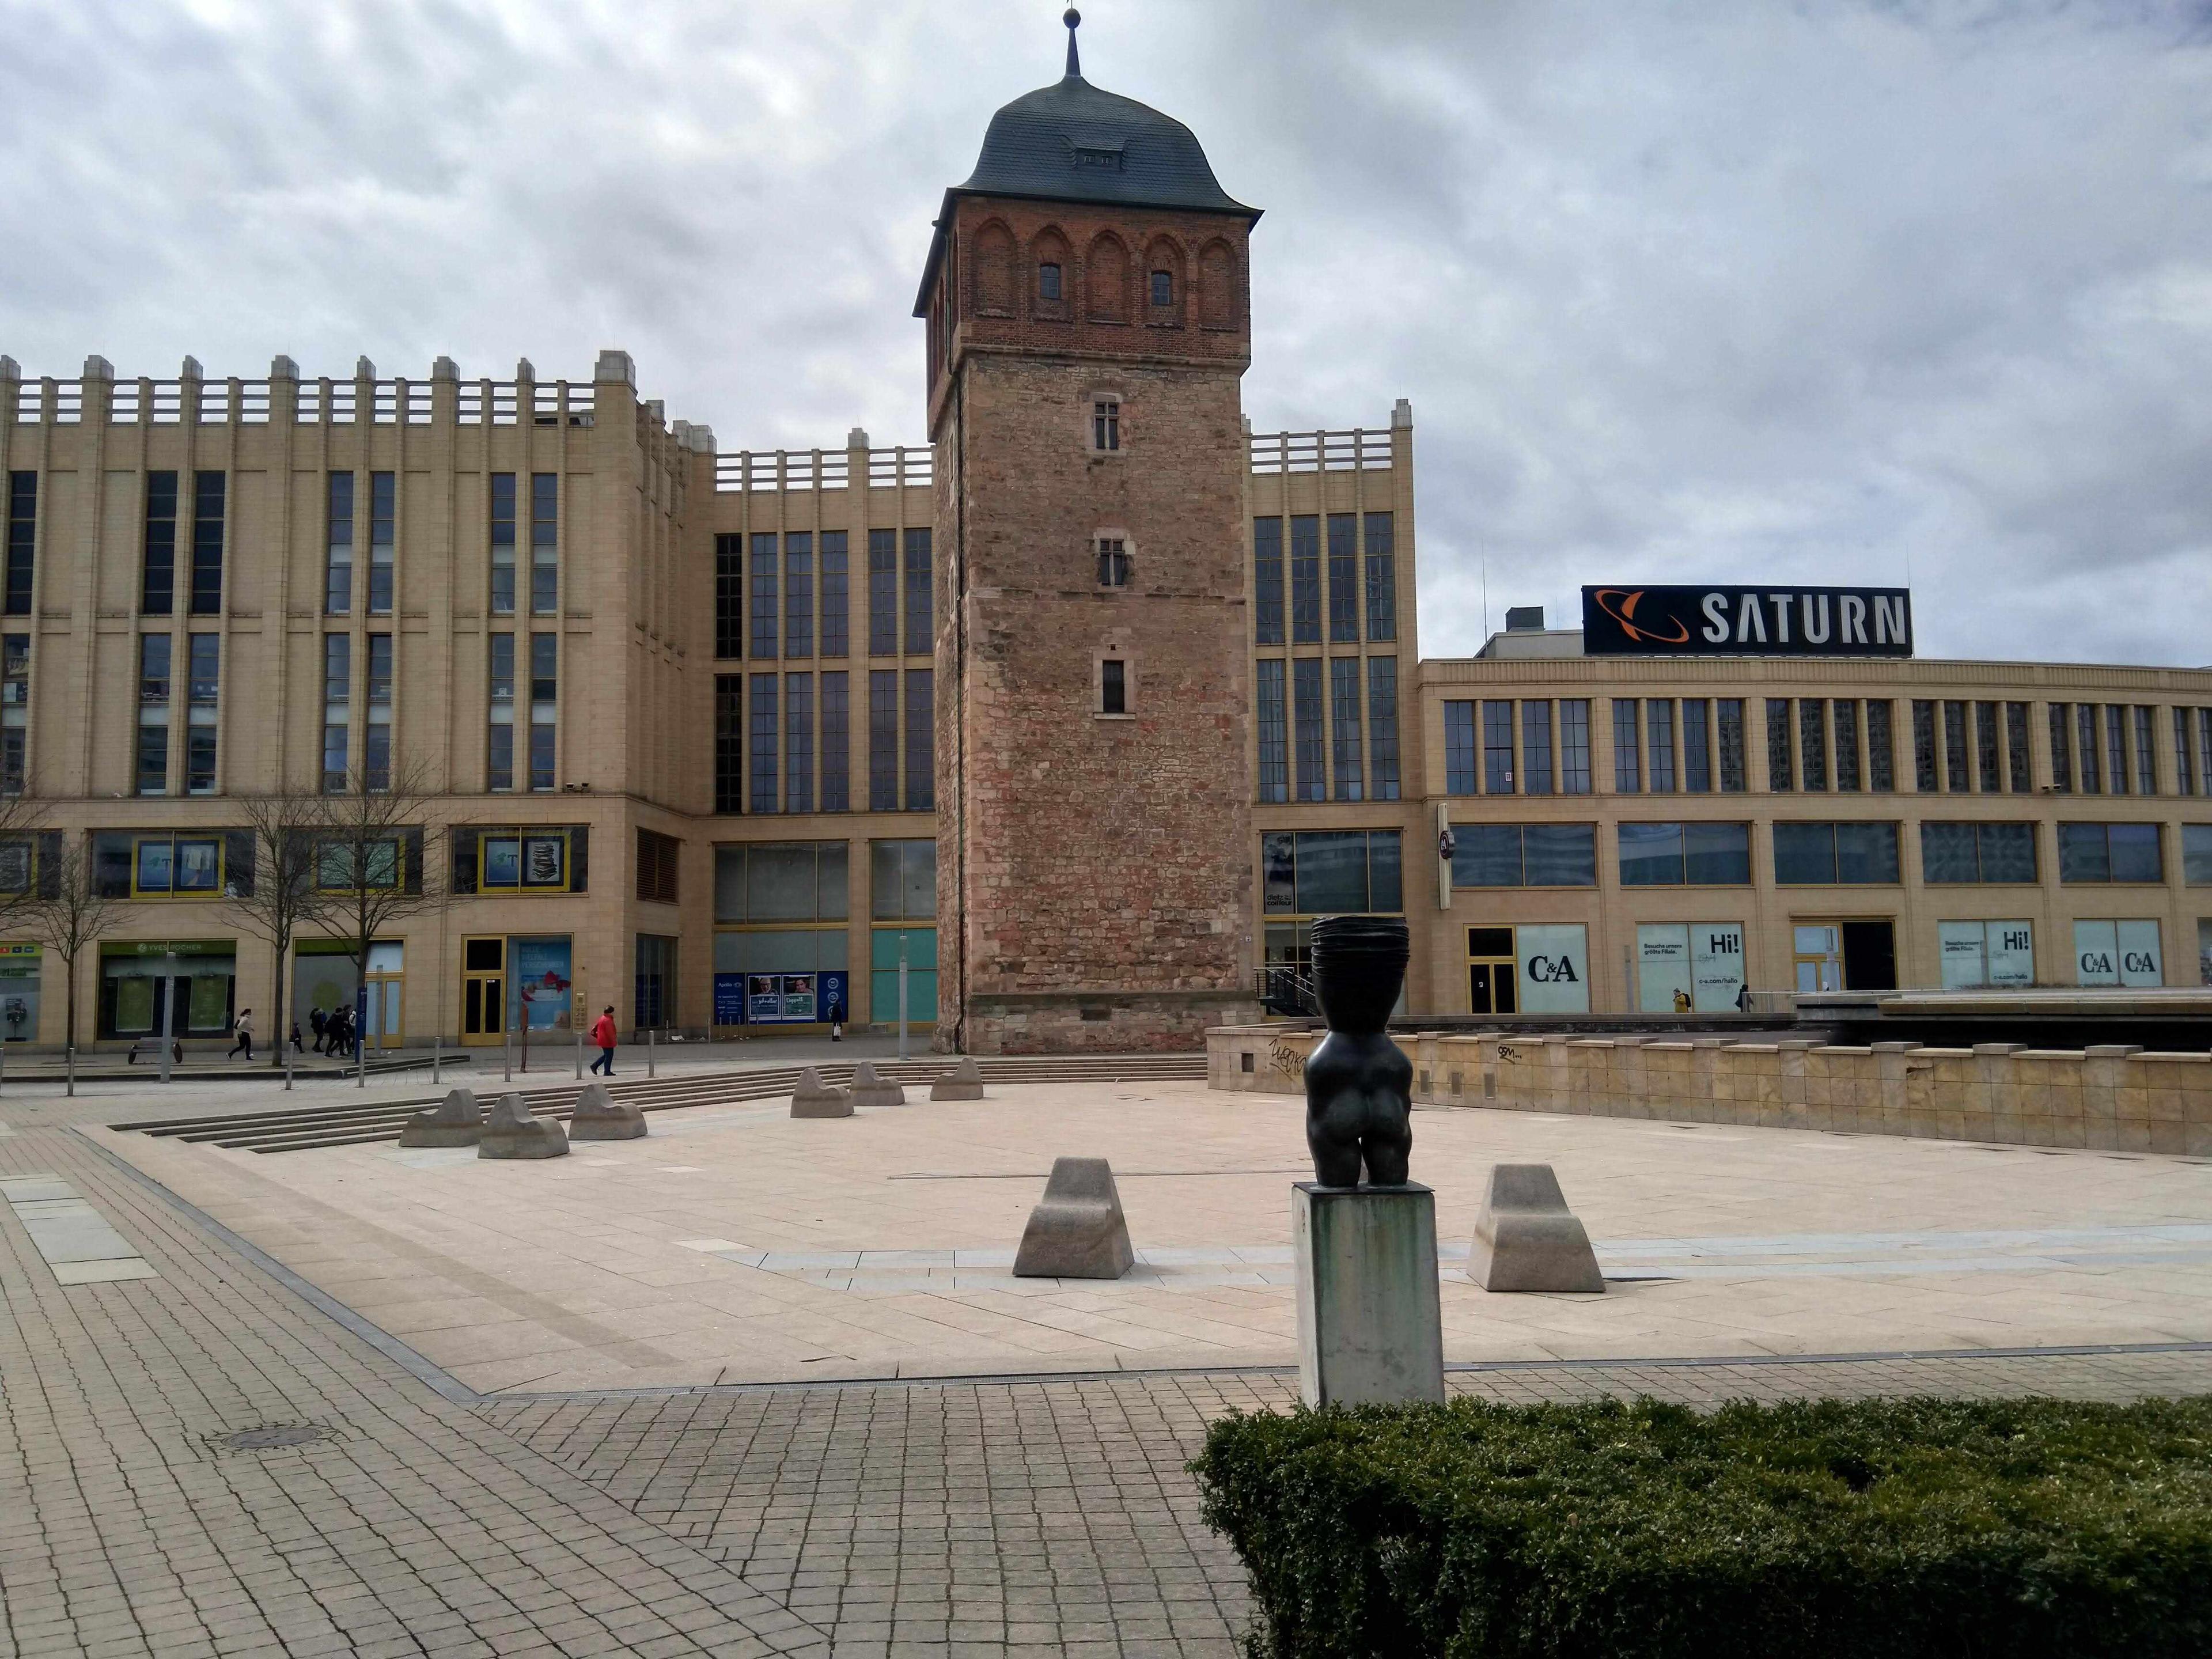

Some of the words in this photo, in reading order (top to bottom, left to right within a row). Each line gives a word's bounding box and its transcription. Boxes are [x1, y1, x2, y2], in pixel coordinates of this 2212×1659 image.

[1699, 592, 1907, 645] SATURN
[1710, 934, 1739, 954] Hi!
[2003, 931, 2029, 950] Hi!
[1528, 955, 1579, 982] C&A
[2081, 952, 2113, 973] C&A
[2124, 952, 2156, 972] C&A
